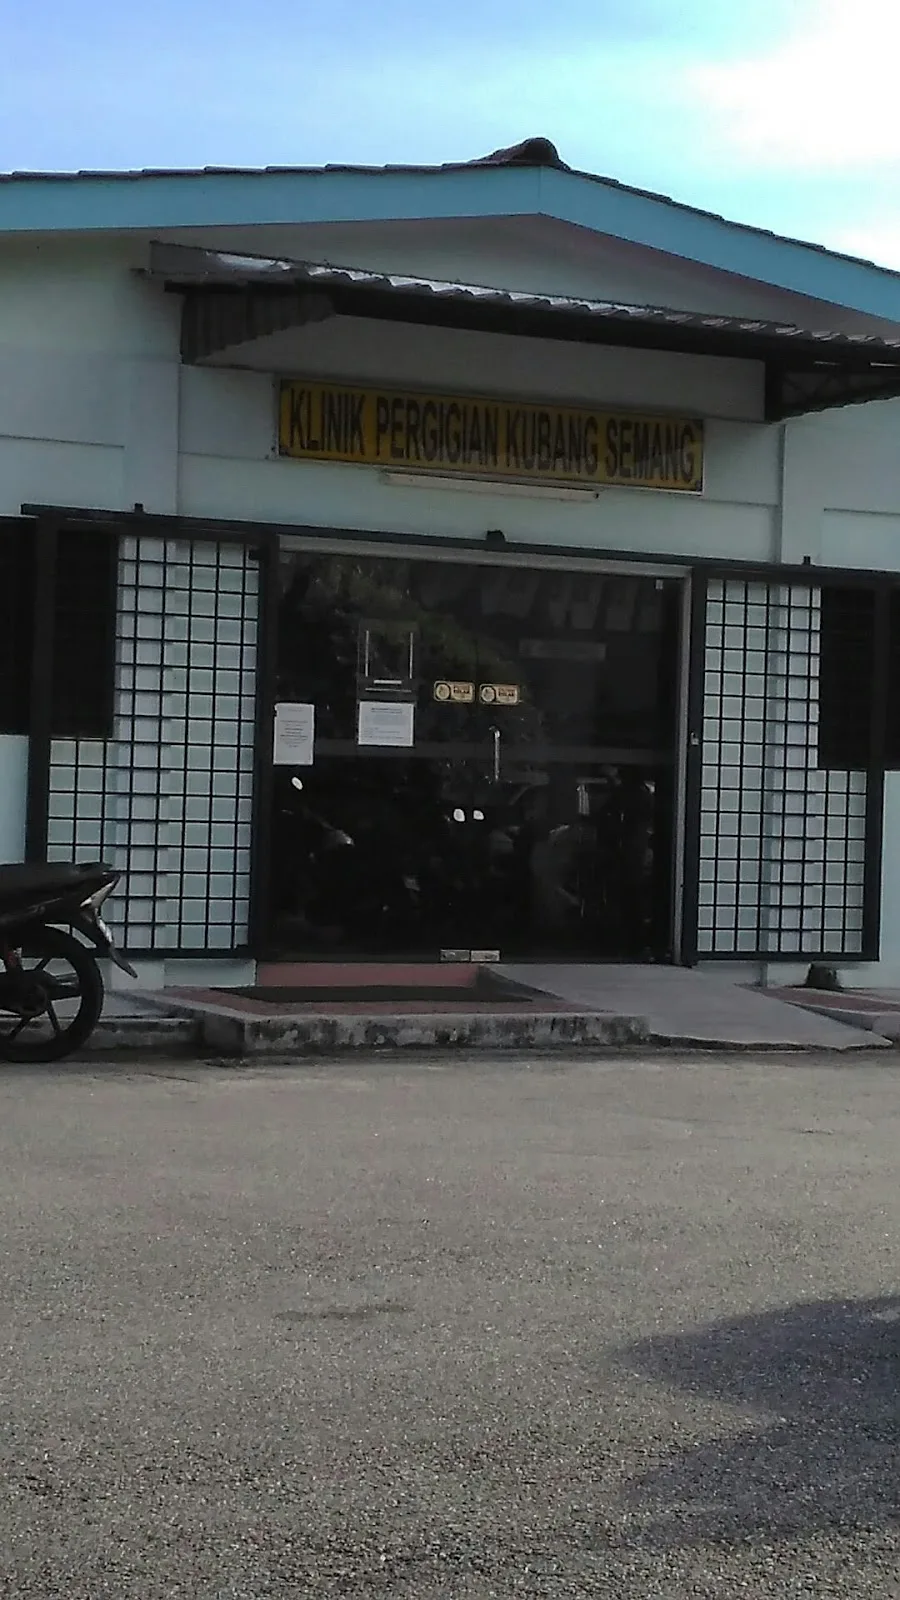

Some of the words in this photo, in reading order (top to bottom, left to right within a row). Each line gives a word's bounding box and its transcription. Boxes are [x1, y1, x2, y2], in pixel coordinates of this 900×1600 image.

[290, 387, 365, 456] KLINIK
[376, 396, 498, 466] PERGIGIAN
[506, 409, 599, 476] KUBANG
[605, 418, 695, 482] SEMANG
